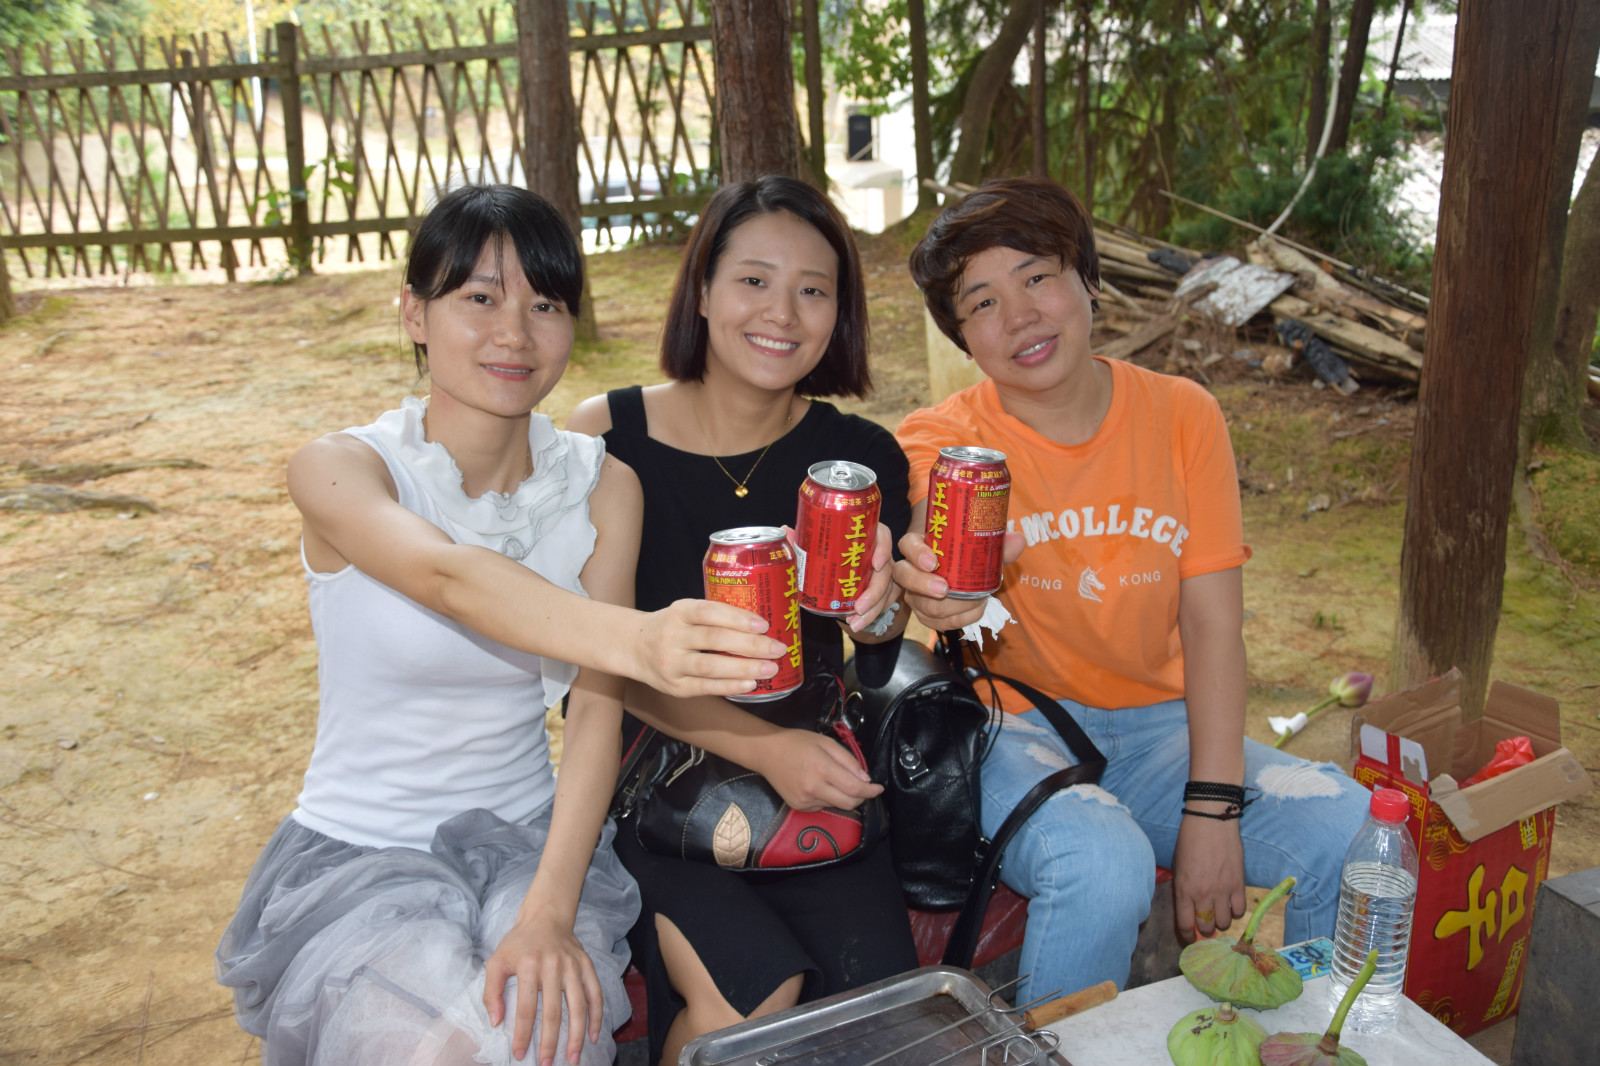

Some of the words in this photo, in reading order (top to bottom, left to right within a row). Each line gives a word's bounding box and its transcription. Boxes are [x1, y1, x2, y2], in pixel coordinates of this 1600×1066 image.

[838, 514, 868, 598] 王老吉
[1020, 574, 1063, 591] HONG
[1119, 570, 1162, 587] KONG
[783, 565, 801, 668] 王老吉
